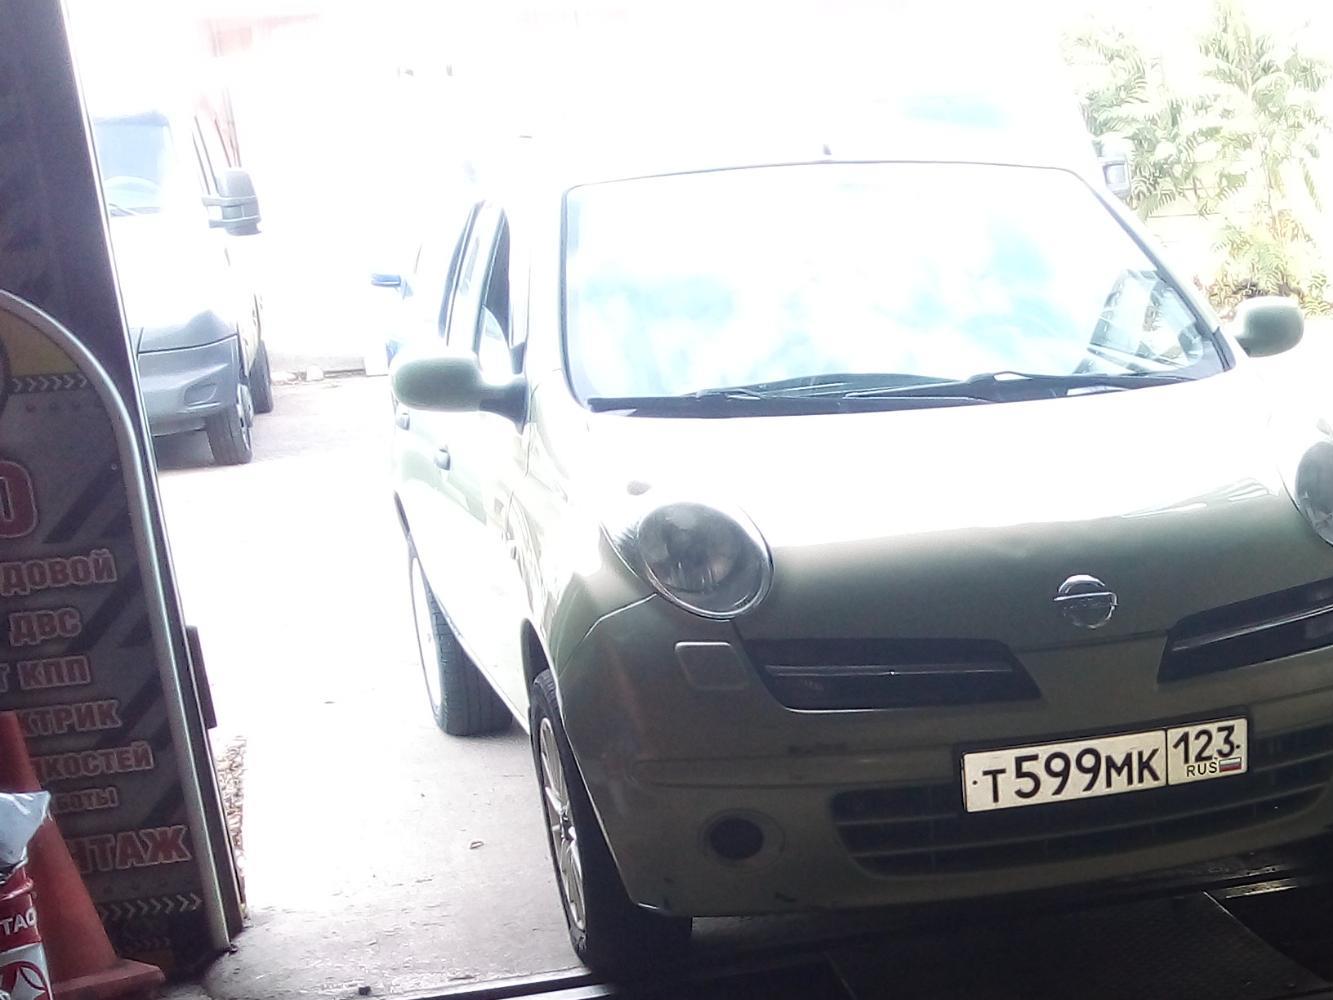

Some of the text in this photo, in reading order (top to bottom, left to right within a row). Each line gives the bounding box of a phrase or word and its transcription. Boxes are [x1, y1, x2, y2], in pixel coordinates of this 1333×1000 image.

[0, 548, 118, 597] ДОВОЙ
[9, 606, 83, 647] ДВС
[17, 654, 92, 691] КПП
[18, 700, 122, 738] КТРИК
[37, 741, 155, 781] КОСТЕЙ
[1173, 725, 1235, 765] 123
[1186, 761, 1218, 777] RUS
[54, 785, 120, 814] БОТЫ
[70, 825, 193, 873] НТАЖ
